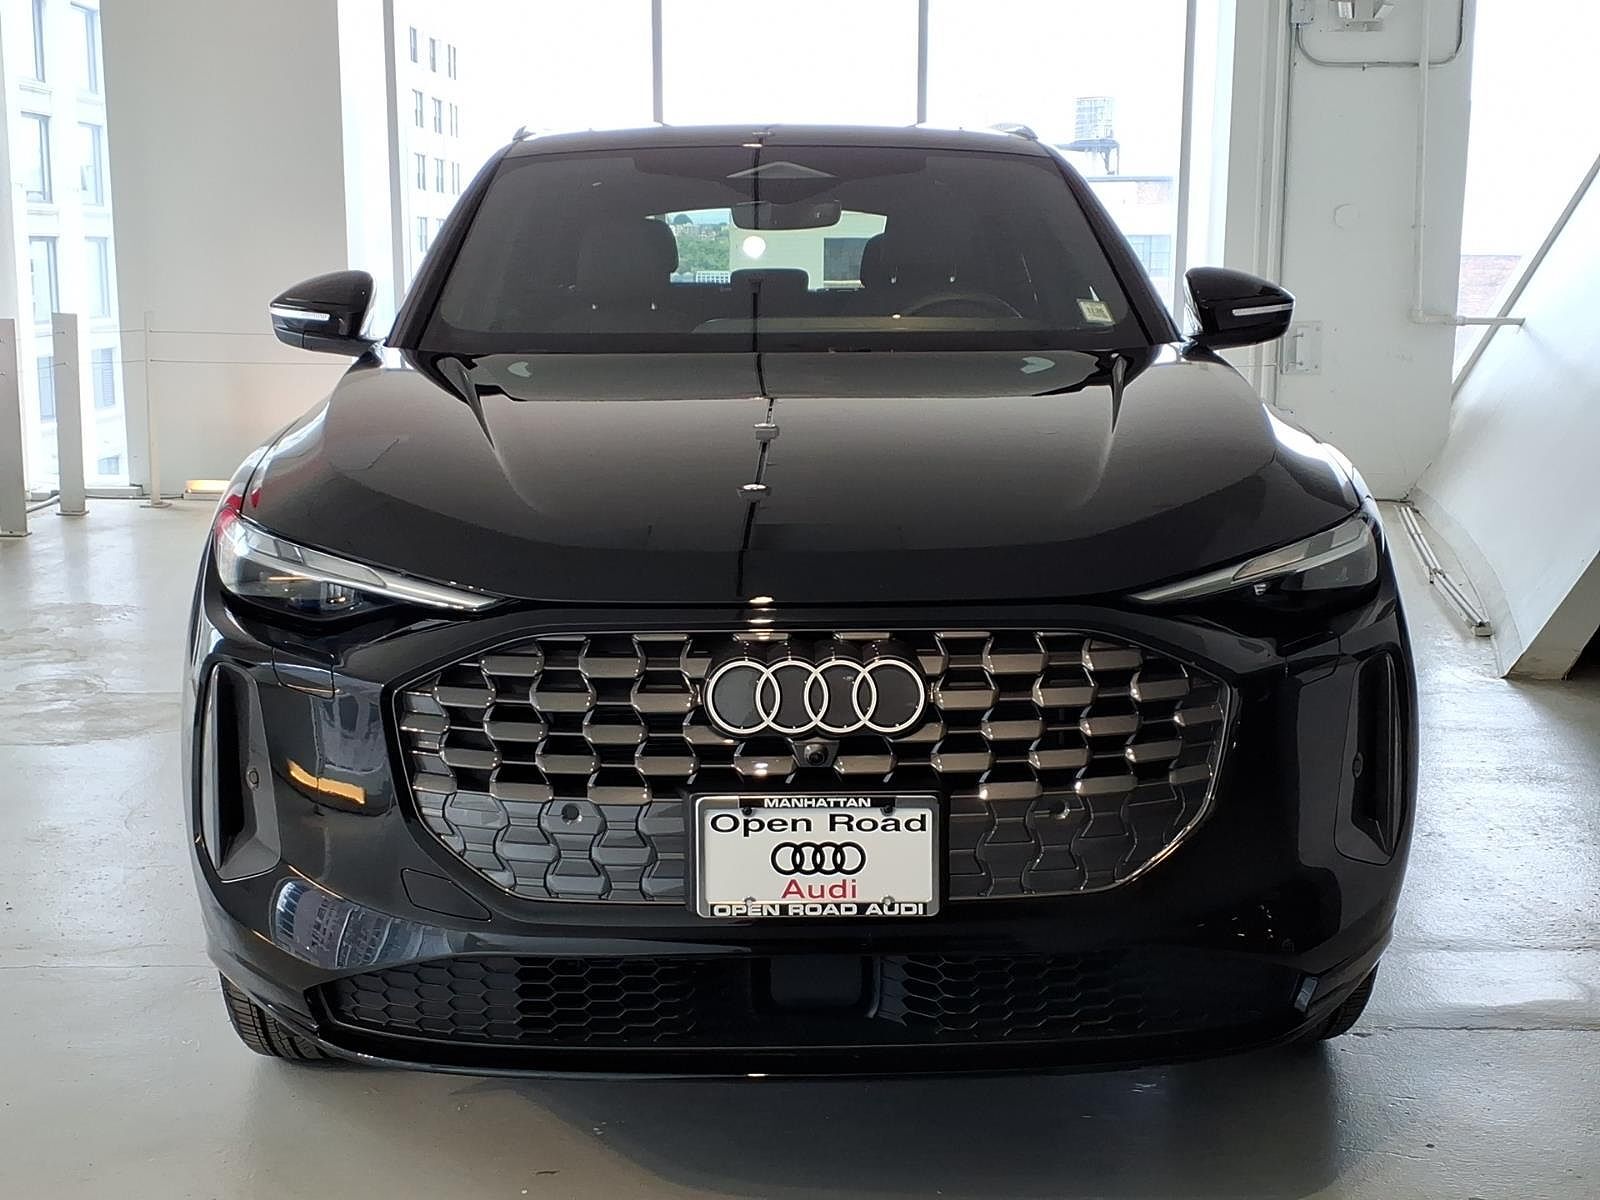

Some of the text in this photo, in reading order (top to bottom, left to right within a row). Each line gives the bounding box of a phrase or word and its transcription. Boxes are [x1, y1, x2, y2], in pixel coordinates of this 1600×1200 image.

[764, 798, 871, 808] MANHATTAN
[710, 813, 927, 837] Open Road
[781, 879, 857, 899] Audi
[713, 903, 924, 917] OPEN ROAD AUDI
